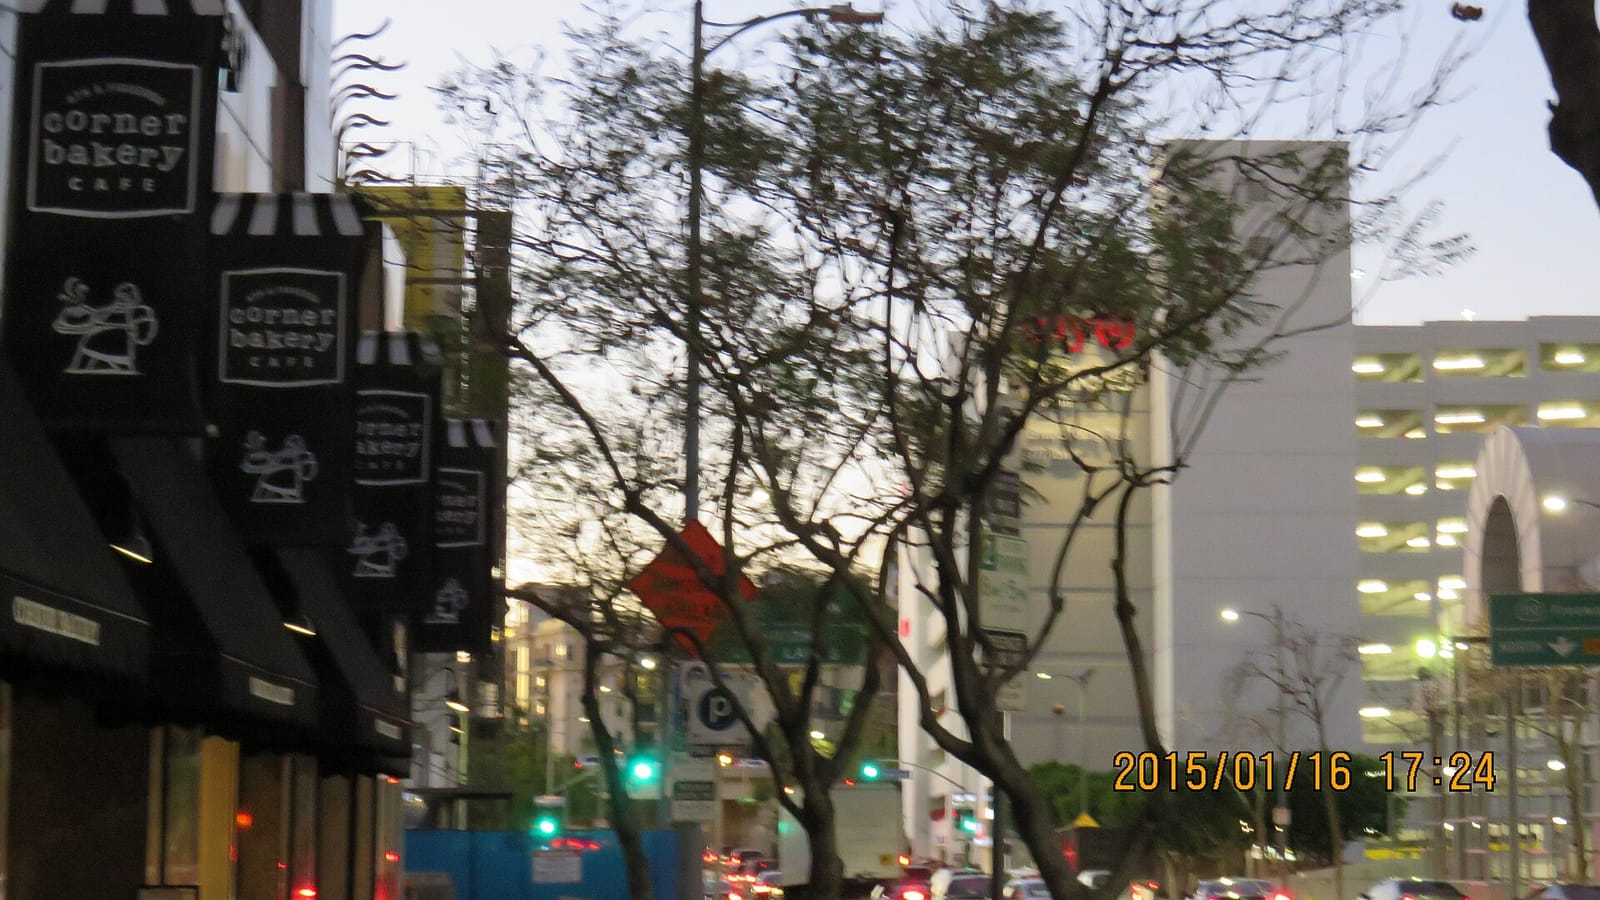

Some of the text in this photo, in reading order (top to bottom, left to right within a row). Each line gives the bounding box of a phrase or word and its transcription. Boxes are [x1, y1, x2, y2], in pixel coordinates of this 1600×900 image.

[42, 110, 188, 136] corner
[42, 138, 184, 172] bakery
[67, 177, 156, 192] CAFE
[230, 306, 336, 326] corner
[230, 328, 336, 352] bakery
[356, 422, 422, 437] orner
[356, 441, 422, 458] akery
